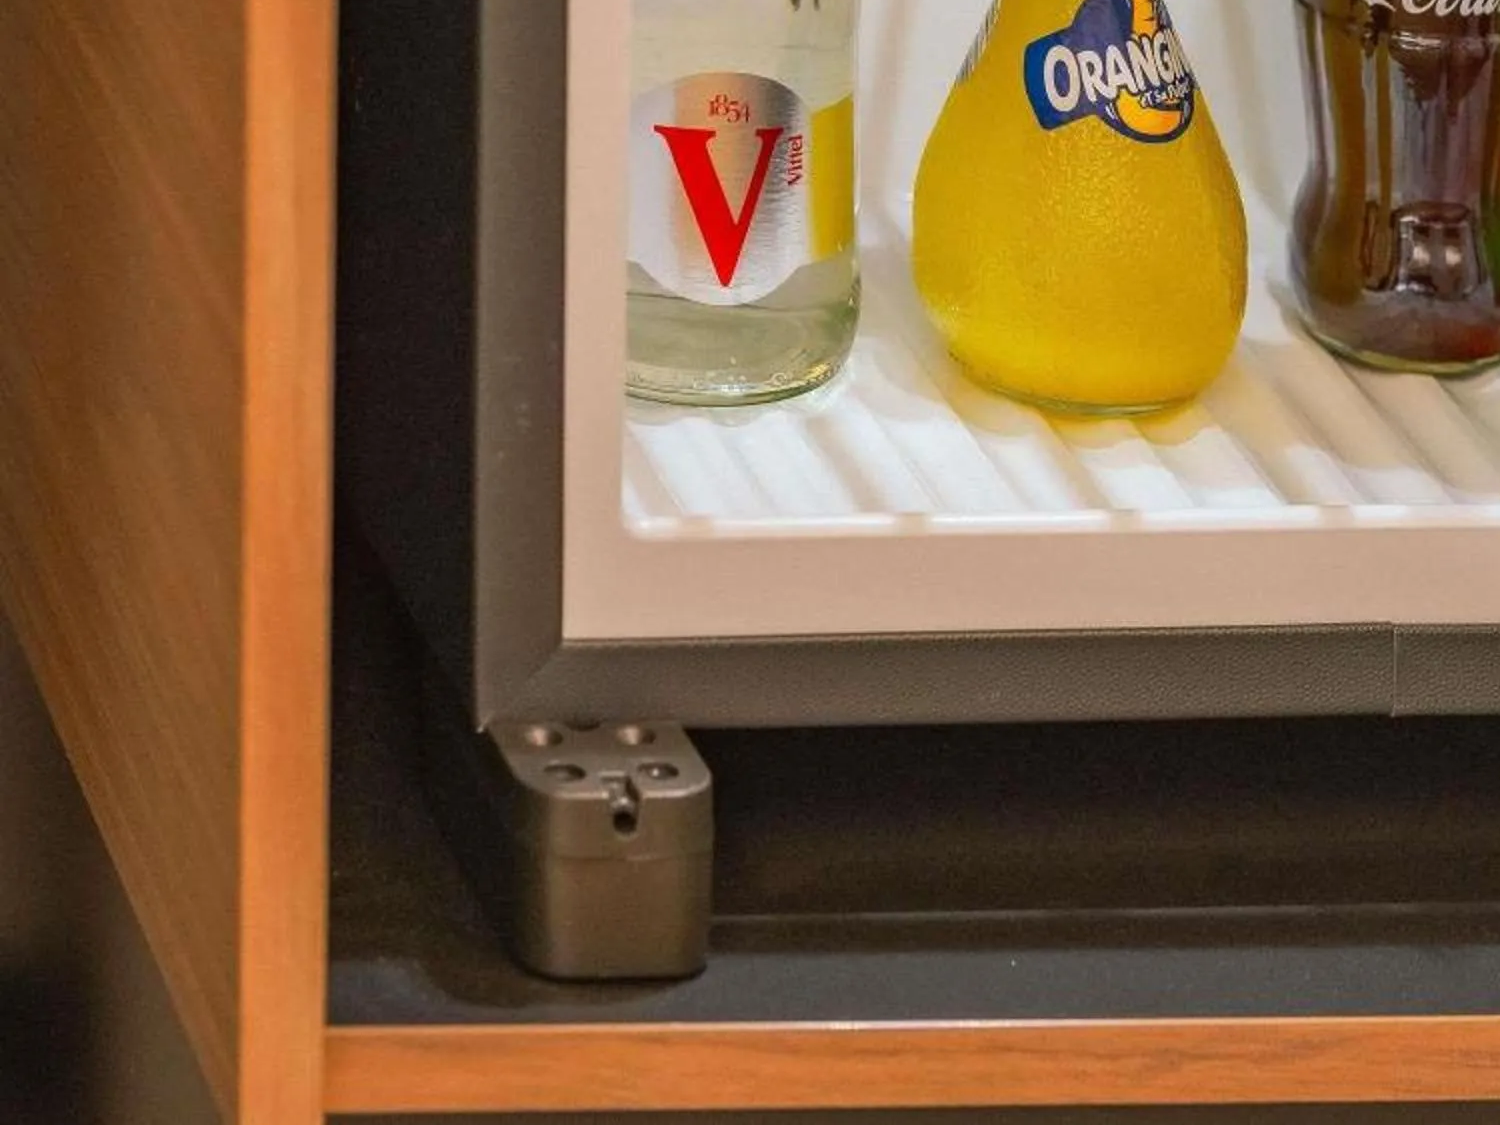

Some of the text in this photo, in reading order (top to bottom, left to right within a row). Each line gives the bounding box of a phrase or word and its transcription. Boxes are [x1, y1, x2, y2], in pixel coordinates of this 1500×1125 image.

[709, 94, 750, 123] 1854
[787, 135, 803, 187] Vittel
[653, 124, 785, 288] V
